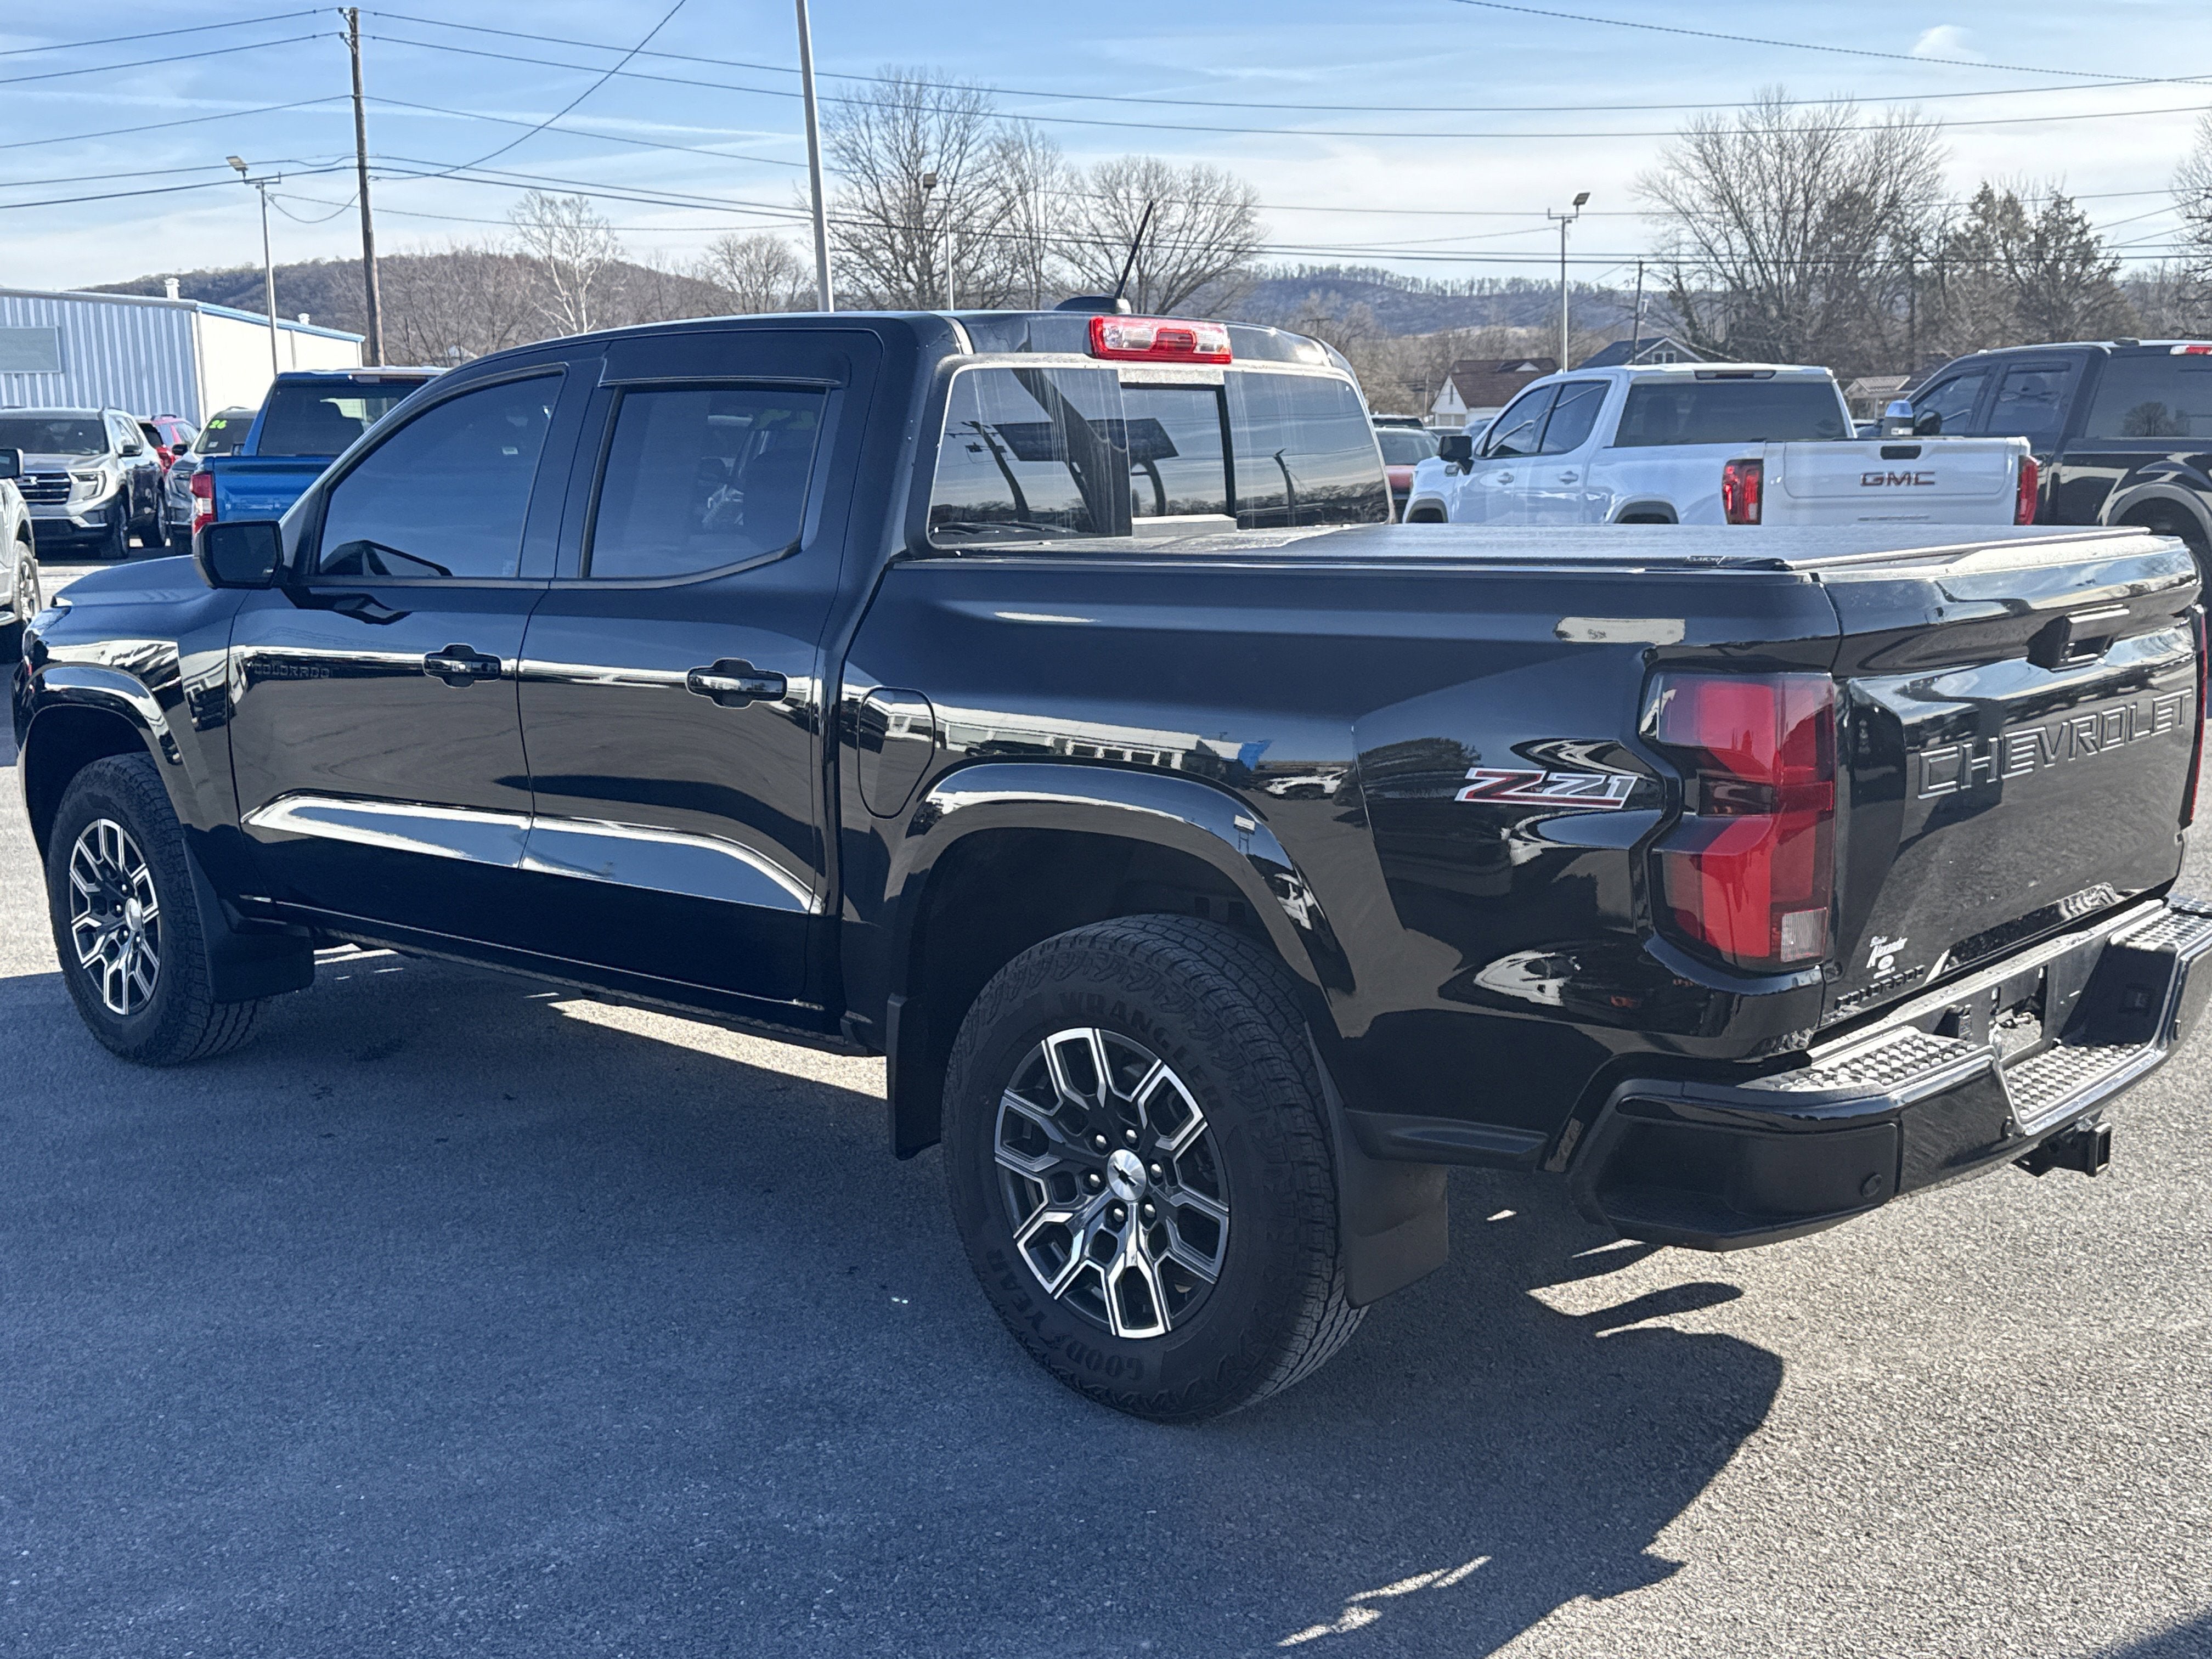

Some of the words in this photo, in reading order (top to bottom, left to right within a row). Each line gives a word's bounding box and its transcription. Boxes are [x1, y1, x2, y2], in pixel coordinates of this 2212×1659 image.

[209, 419, 228, 429] 26
[1860, 471, 1936, 486] GMC
[254, 663, 330, 678] COLORADO
[1918, 688, 2193, 799] CHEVROLET
[1454, 767, 1638, 809] Z71
[1059, 991, 1225, 1113] WRANGLER
